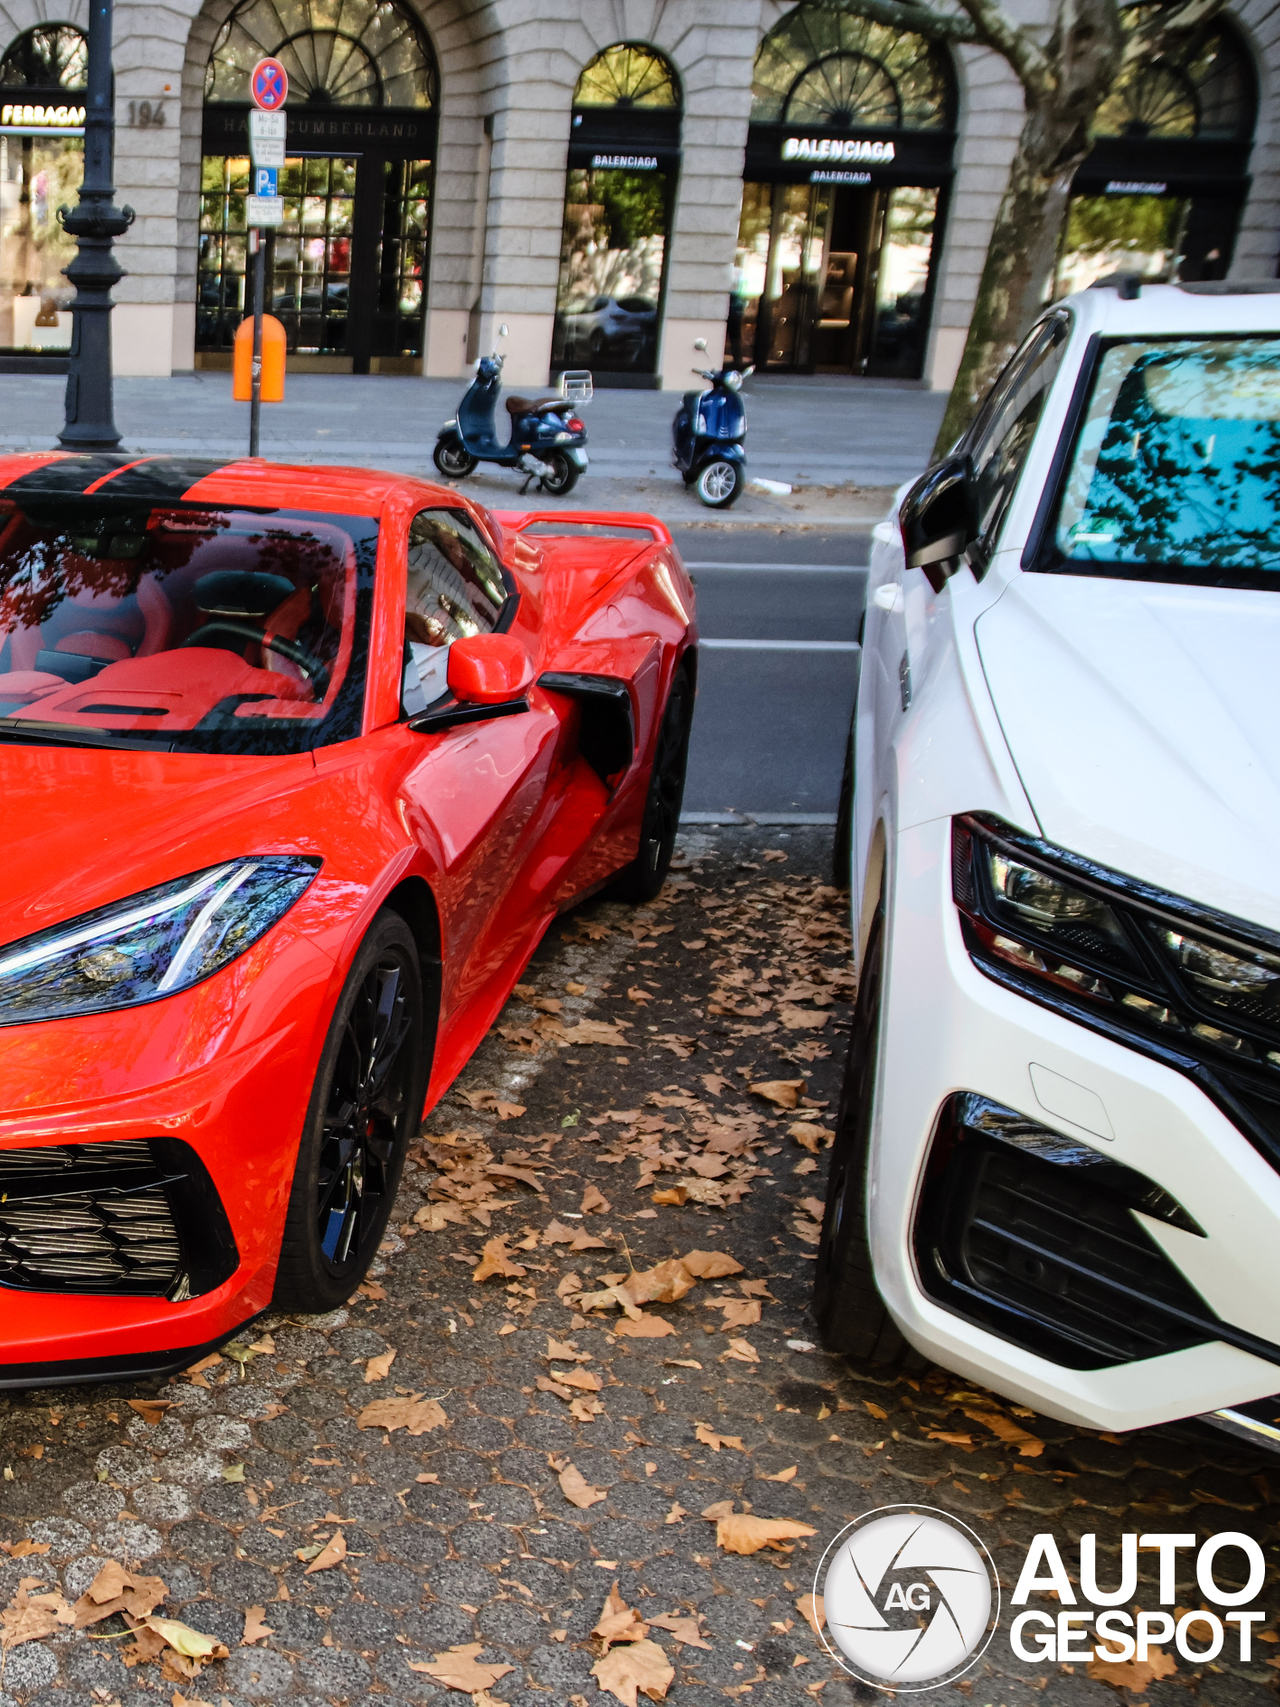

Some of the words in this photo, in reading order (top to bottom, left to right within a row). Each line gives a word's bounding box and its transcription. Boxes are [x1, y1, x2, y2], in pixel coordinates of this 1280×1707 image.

[128, 100, 166, 128] 194
[224, 119, 249, 132] HA
[287, 122, 418, 136] CUMBERLAND
[781, 137, 895, 162] BALENCIAGA
[593, 154, 658, 169] BALENCIAGA
[258, 169, 270, 193] P
[811, 170, 871, 183] BALENCIAGA
